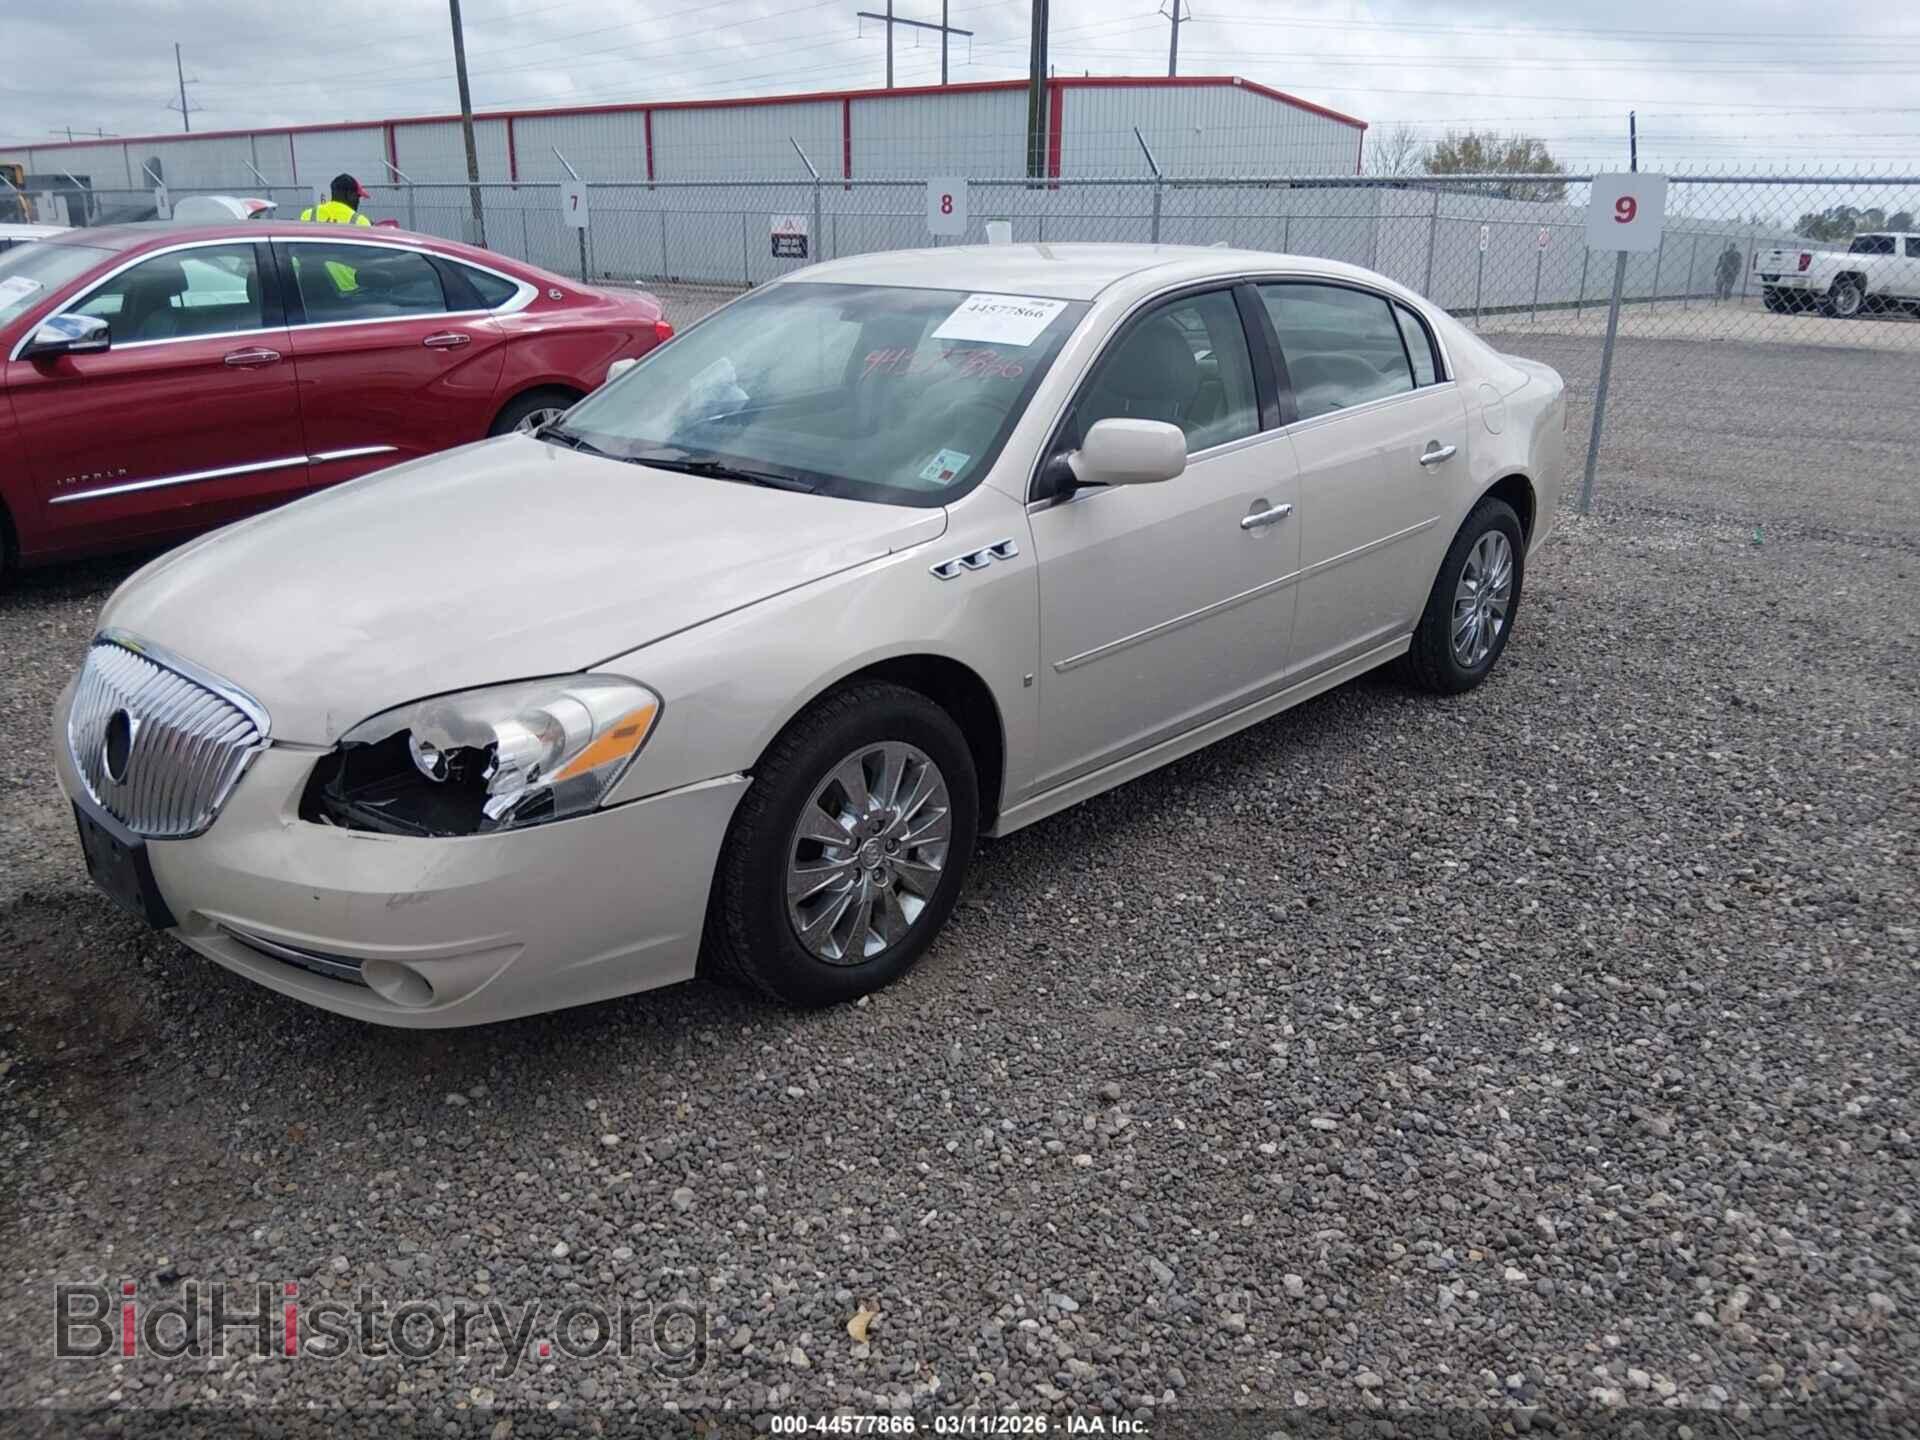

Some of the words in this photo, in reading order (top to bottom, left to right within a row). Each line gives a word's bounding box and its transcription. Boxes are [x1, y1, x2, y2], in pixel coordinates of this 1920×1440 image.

[570, 195, 578, 210] 7
[941, 194, 953, 215] 8
[1614, 196, 1637, 224] 9
[968, 303, 1045, 319] 44577866
